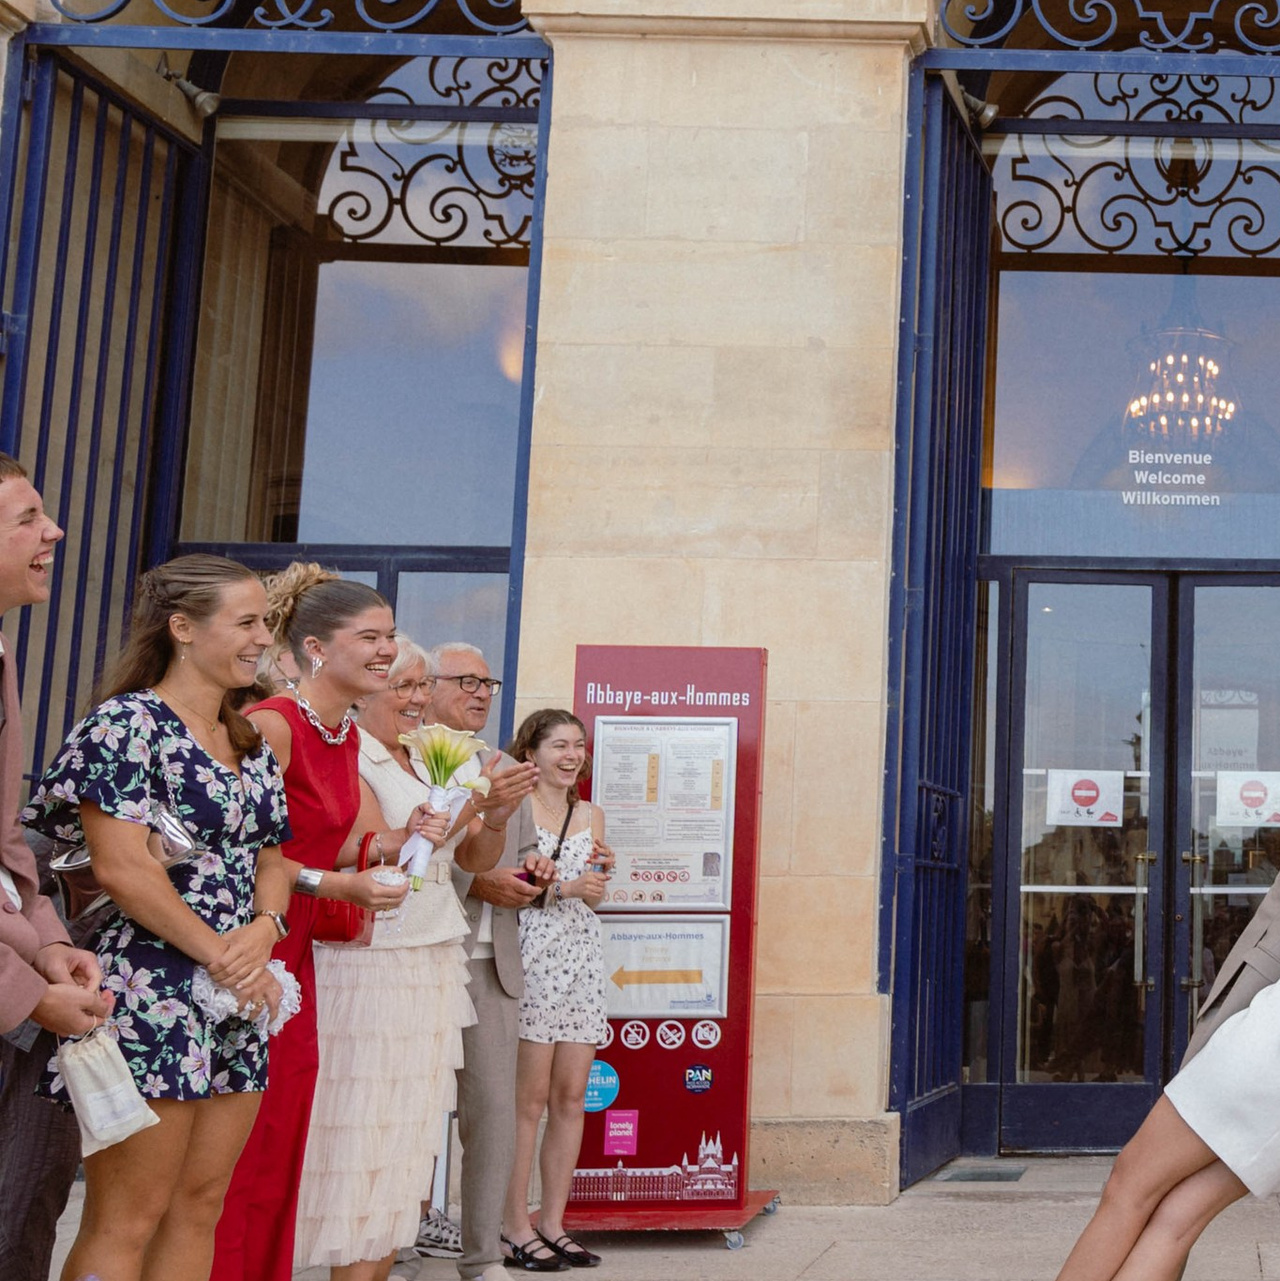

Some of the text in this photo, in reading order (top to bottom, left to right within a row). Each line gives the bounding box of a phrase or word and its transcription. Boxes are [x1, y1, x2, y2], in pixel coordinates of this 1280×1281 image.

[1128, 450, 1212, 465] Bienvenue
[1134, 471, 1206, 485] Welcome
[1122, 491, 1221, 506] Willkommen
[586, 682, 750, 711] Abbaye-aux-Hommes
[610, 931, 705, 942] Abbaye-aux-Hommes
[587, 1076, 616, 1084] HELIN
[685, 1068, 712, 1082] PAN
[608, 1128, 633, 1137] planet
[609, 1121, 634, 1131] lonely
